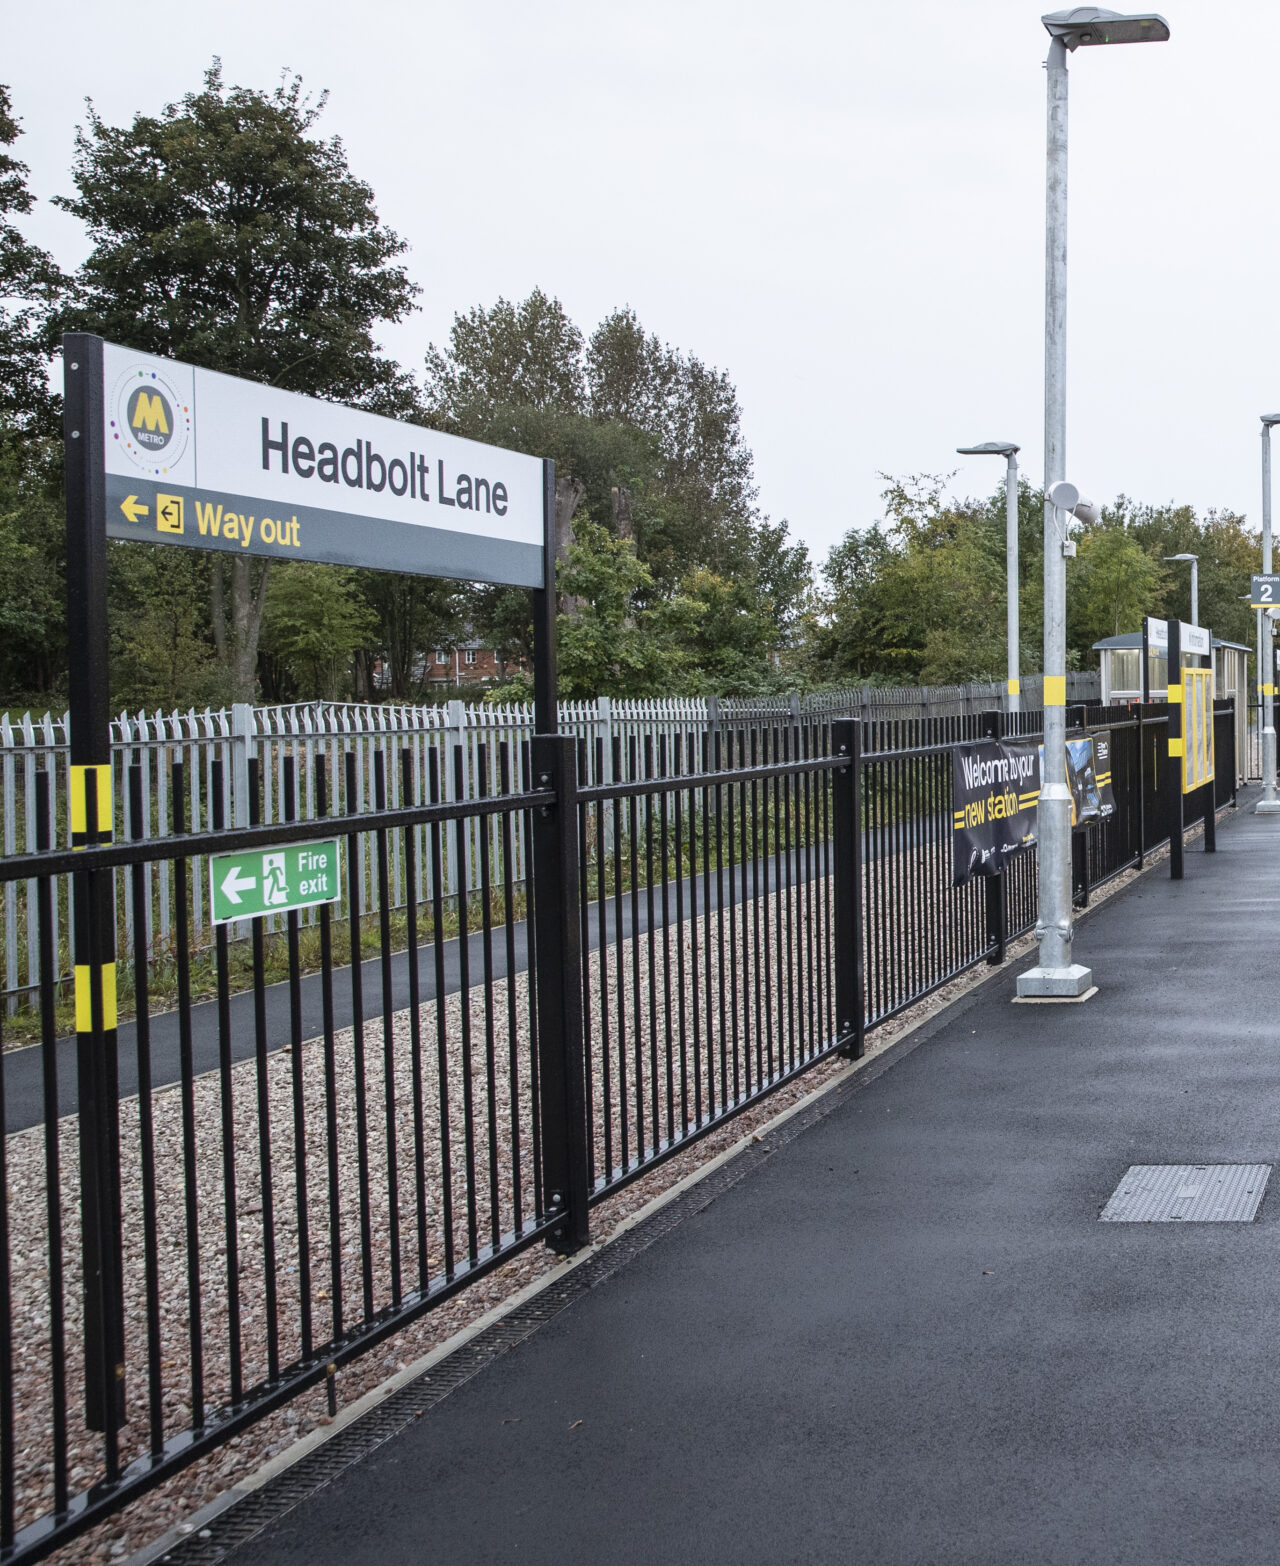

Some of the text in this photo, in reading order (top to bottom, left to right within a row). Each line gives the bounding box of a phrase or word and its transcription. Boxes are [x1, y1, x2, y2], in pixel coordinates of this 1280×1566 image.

[137, 431, 165, 446] METRO
[261, 416, 508, 516] Headbolt Lane
[195, 501, 300, 547] Way out
[1252, 575, 1280, 583] Platform
[1260, 584, 1273, 602] 2
[962, 753, 1035, 790] Welcome to your
[965, 786, 1019, 829] new station
[298, 852, 328, 872] Fire
[299, 873, 328, 895] exit
